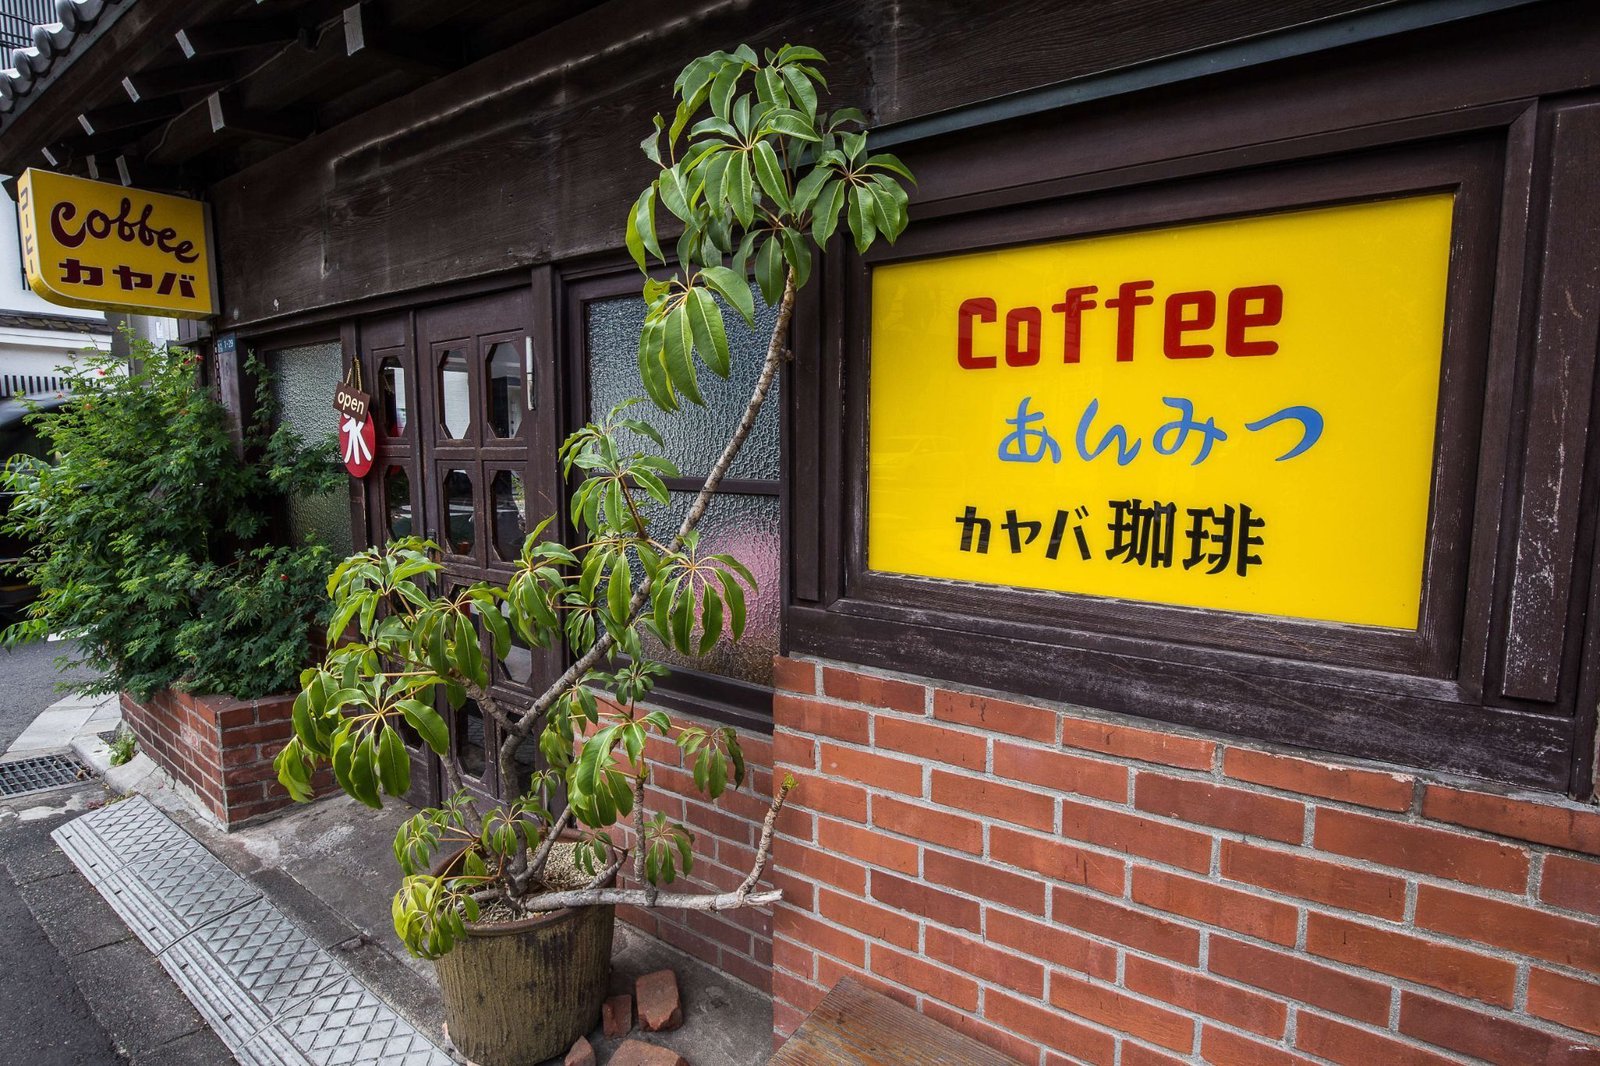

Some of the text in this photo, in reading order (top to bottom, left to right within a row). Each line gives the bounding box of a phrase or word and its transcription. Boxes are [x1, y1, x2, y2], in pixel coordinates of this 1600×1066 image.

[20, 187, 34, 274] コーヒー
[50, 197, 200, 264] Coffee
[58, 258, 196, 298] カヤバ
[957, 280, 1284, 370] Coffee
[337, 391, 365, 415] open
[997, 397, 1324, 466] あんみつ
[955, 500, 1266, 577] カヤバ珈琲
